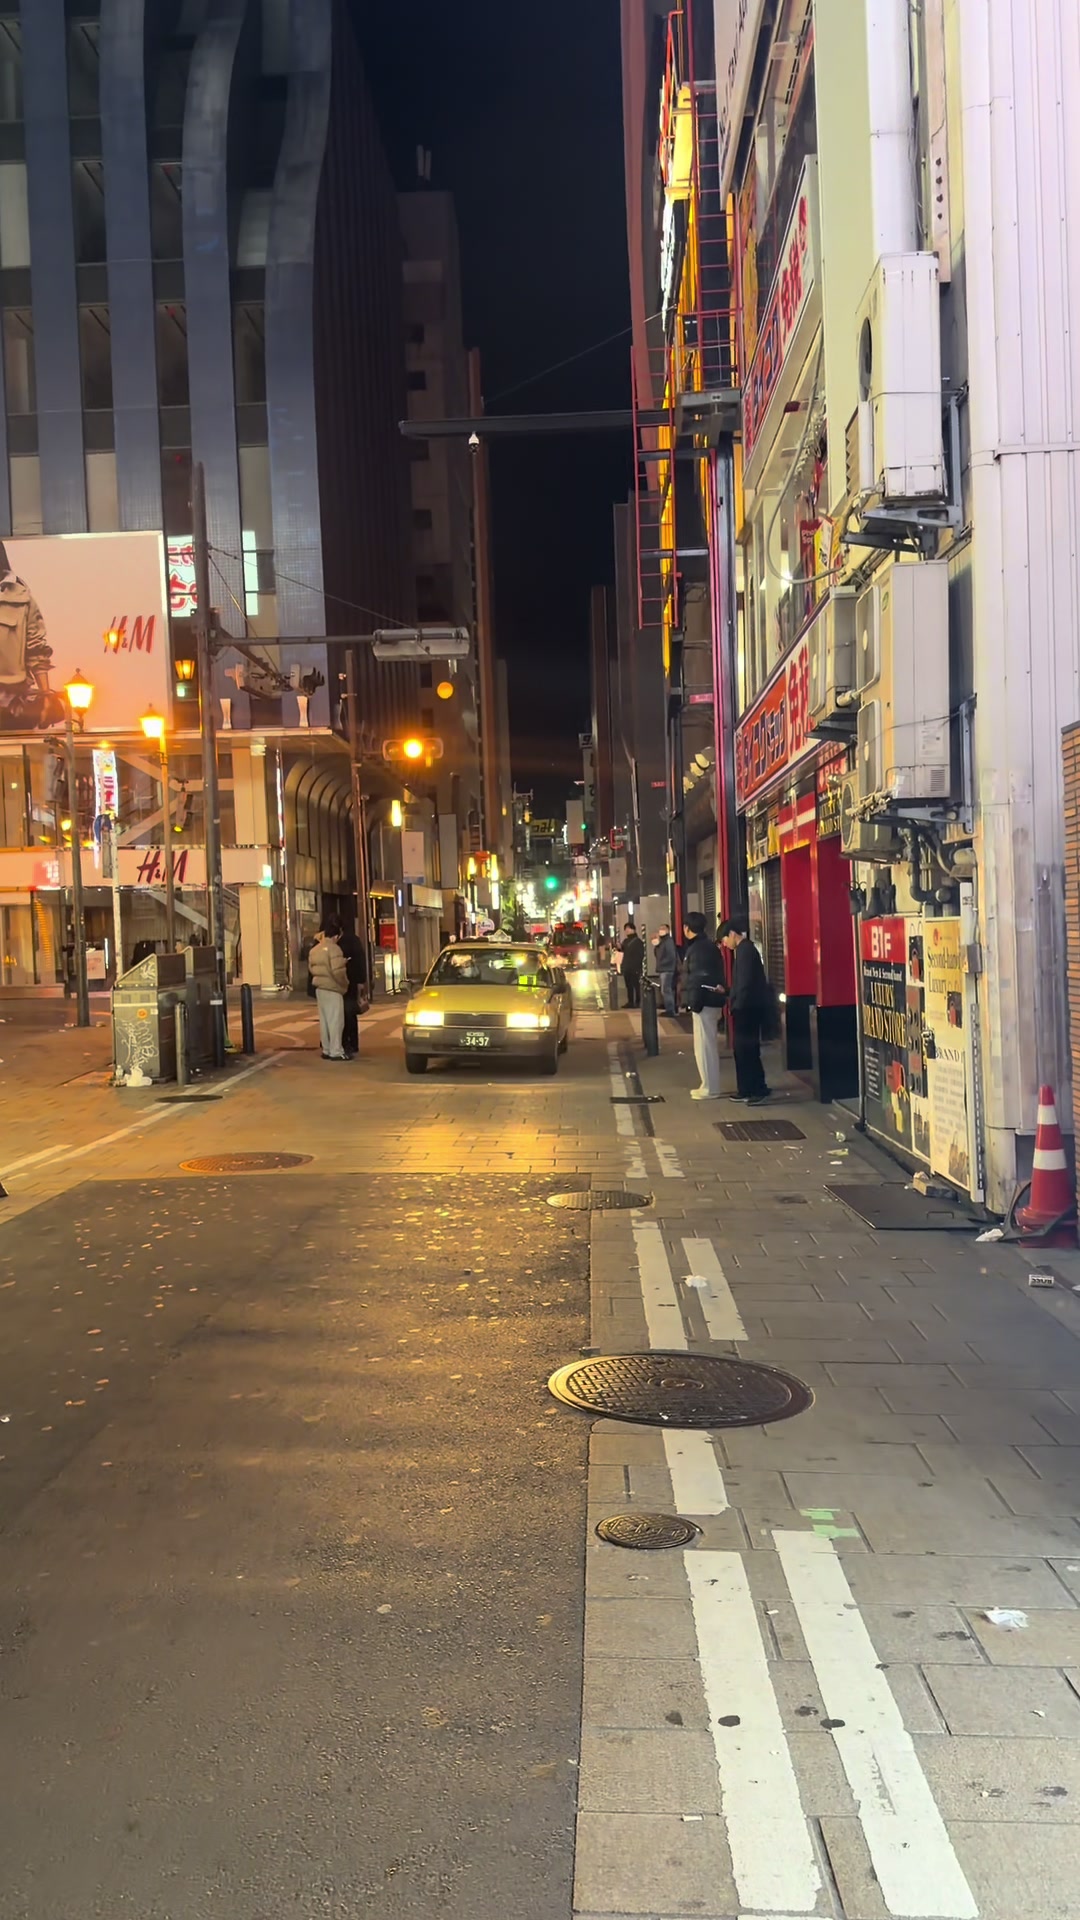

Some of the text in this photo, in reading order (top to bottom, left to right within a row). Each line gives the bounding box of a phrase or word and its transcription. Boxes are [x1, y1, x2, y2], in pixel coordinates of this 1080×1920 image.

[104, 614, 155, 654] H&M
[137, 849, 189, 884] H&M
[884, 1009, 907, 1048] STORE
